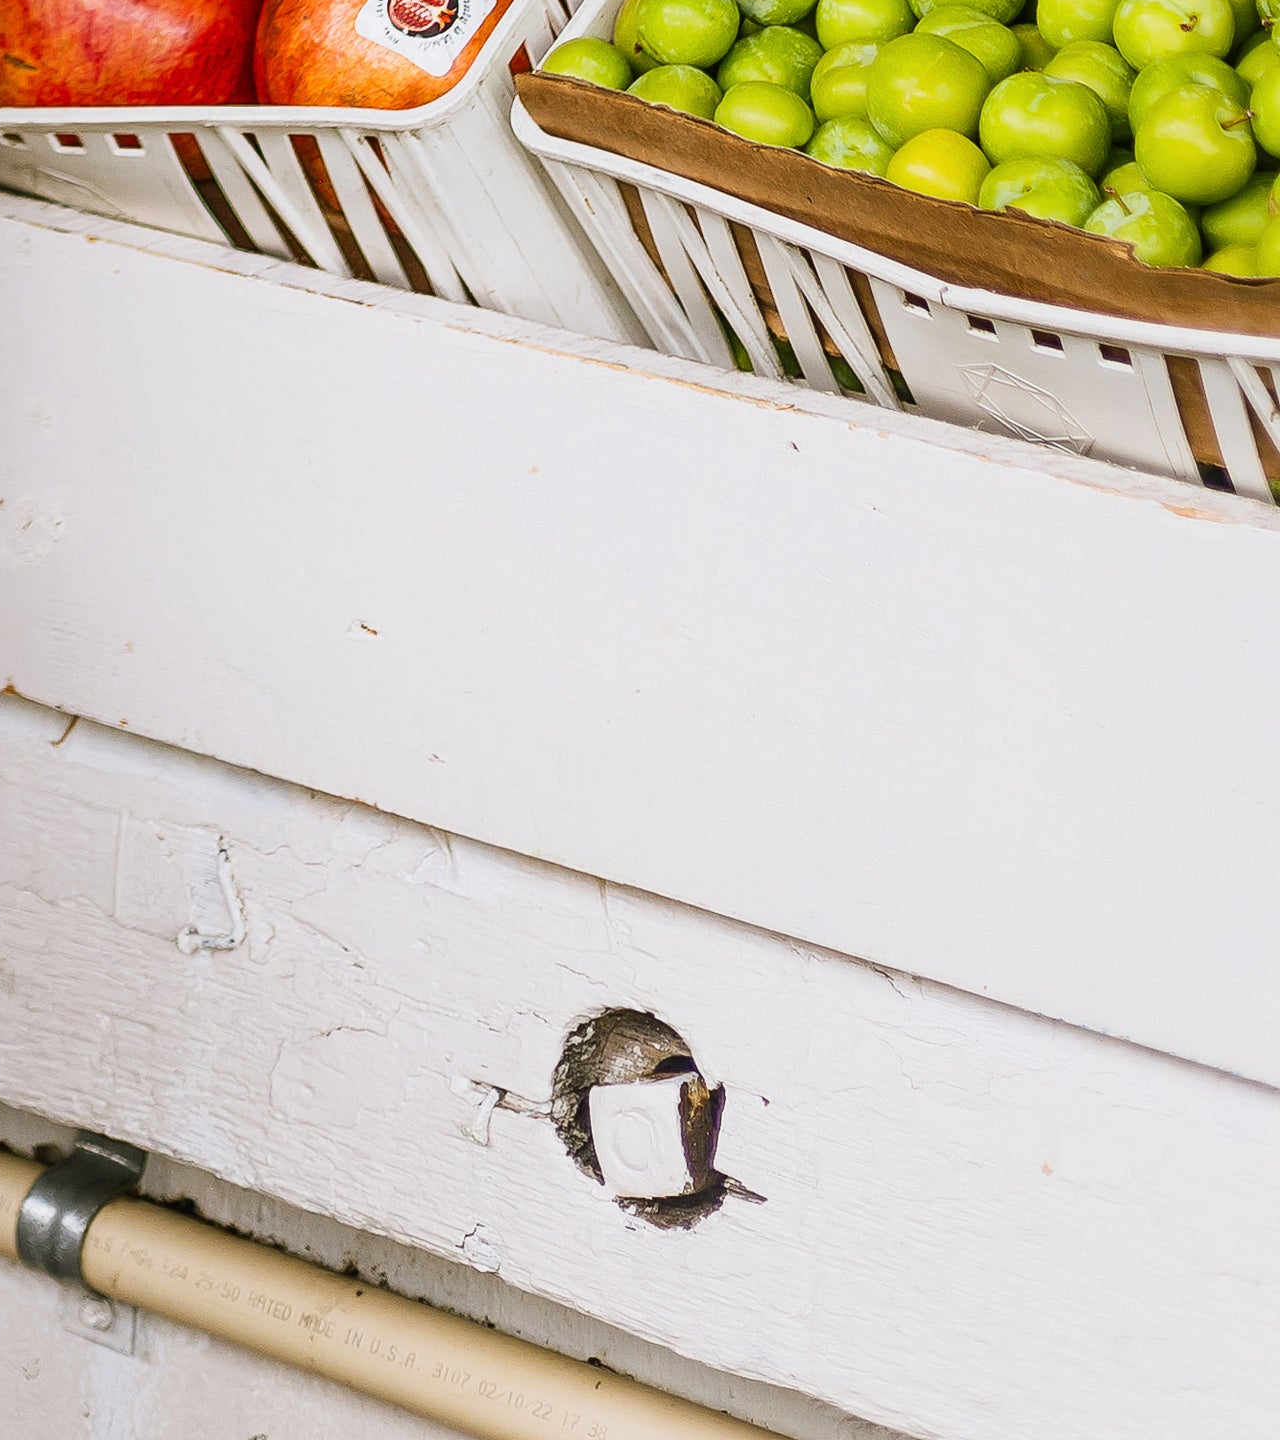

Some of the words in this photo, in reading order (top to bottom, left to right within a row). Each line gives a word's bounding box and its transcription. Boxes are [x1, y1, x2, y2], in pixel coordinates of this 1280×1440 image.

[246, 1291, 293, 1320] RATED
[297, 1311, 336, 1337] MADE
[343, 1329, 362, 1347] IN
[368, 1339, 423, 1370] U.S.A.
[431, 1362, 470, 1389] 3107
[476, 1380, 552, 1419] 02/10/22
